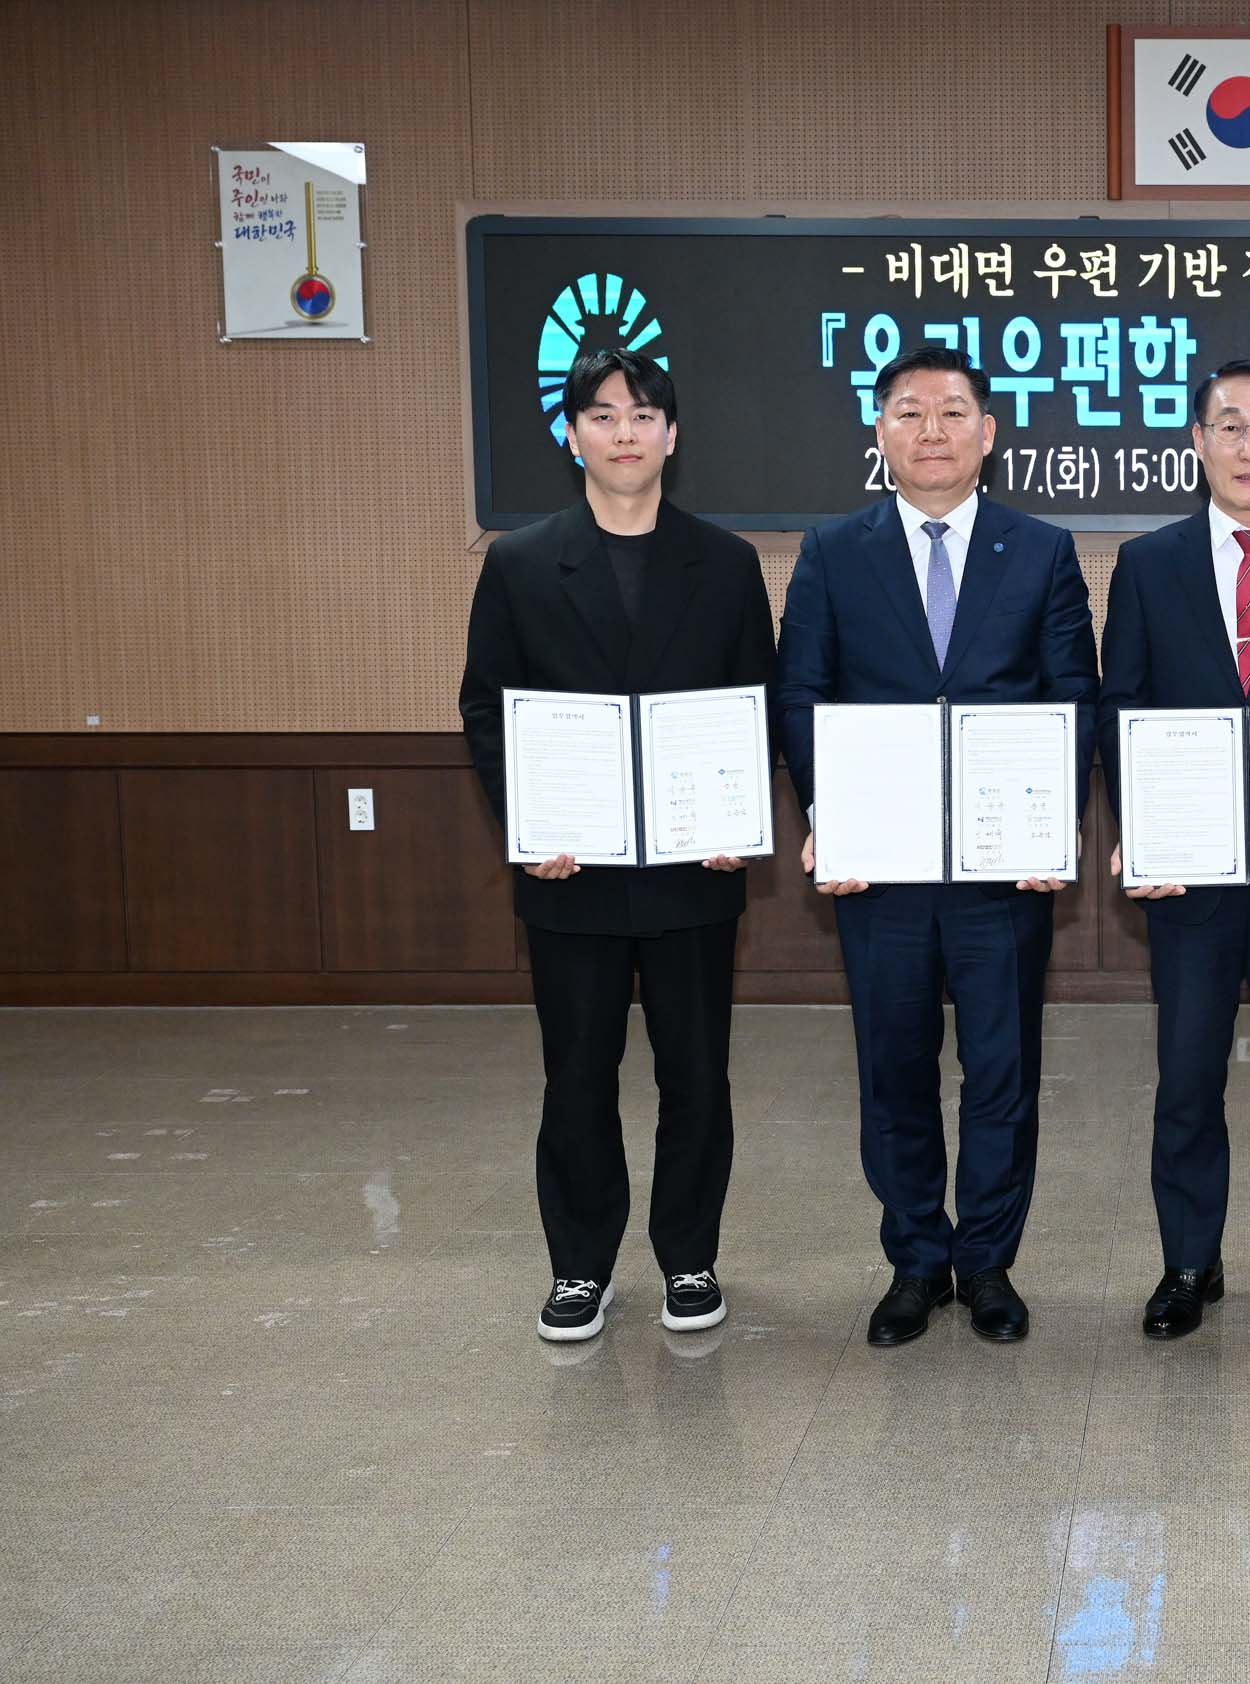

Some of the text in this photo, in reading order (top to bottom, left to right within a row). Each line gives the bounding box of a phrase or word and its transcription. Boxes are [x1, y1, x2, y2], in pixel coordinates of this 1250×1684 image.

[231, 165, 270, 186] 국민이
[234, 220, 297, 242] 대한민국
[886, 243, 1014, 299] 비대면
[1033, 243, 1118, 299] 우편
[1139, 243, 1227, 299] 기반
[1003, 446, 1099, 499] 17.(화)
[1114, 448, 1198, 492] 15:00
